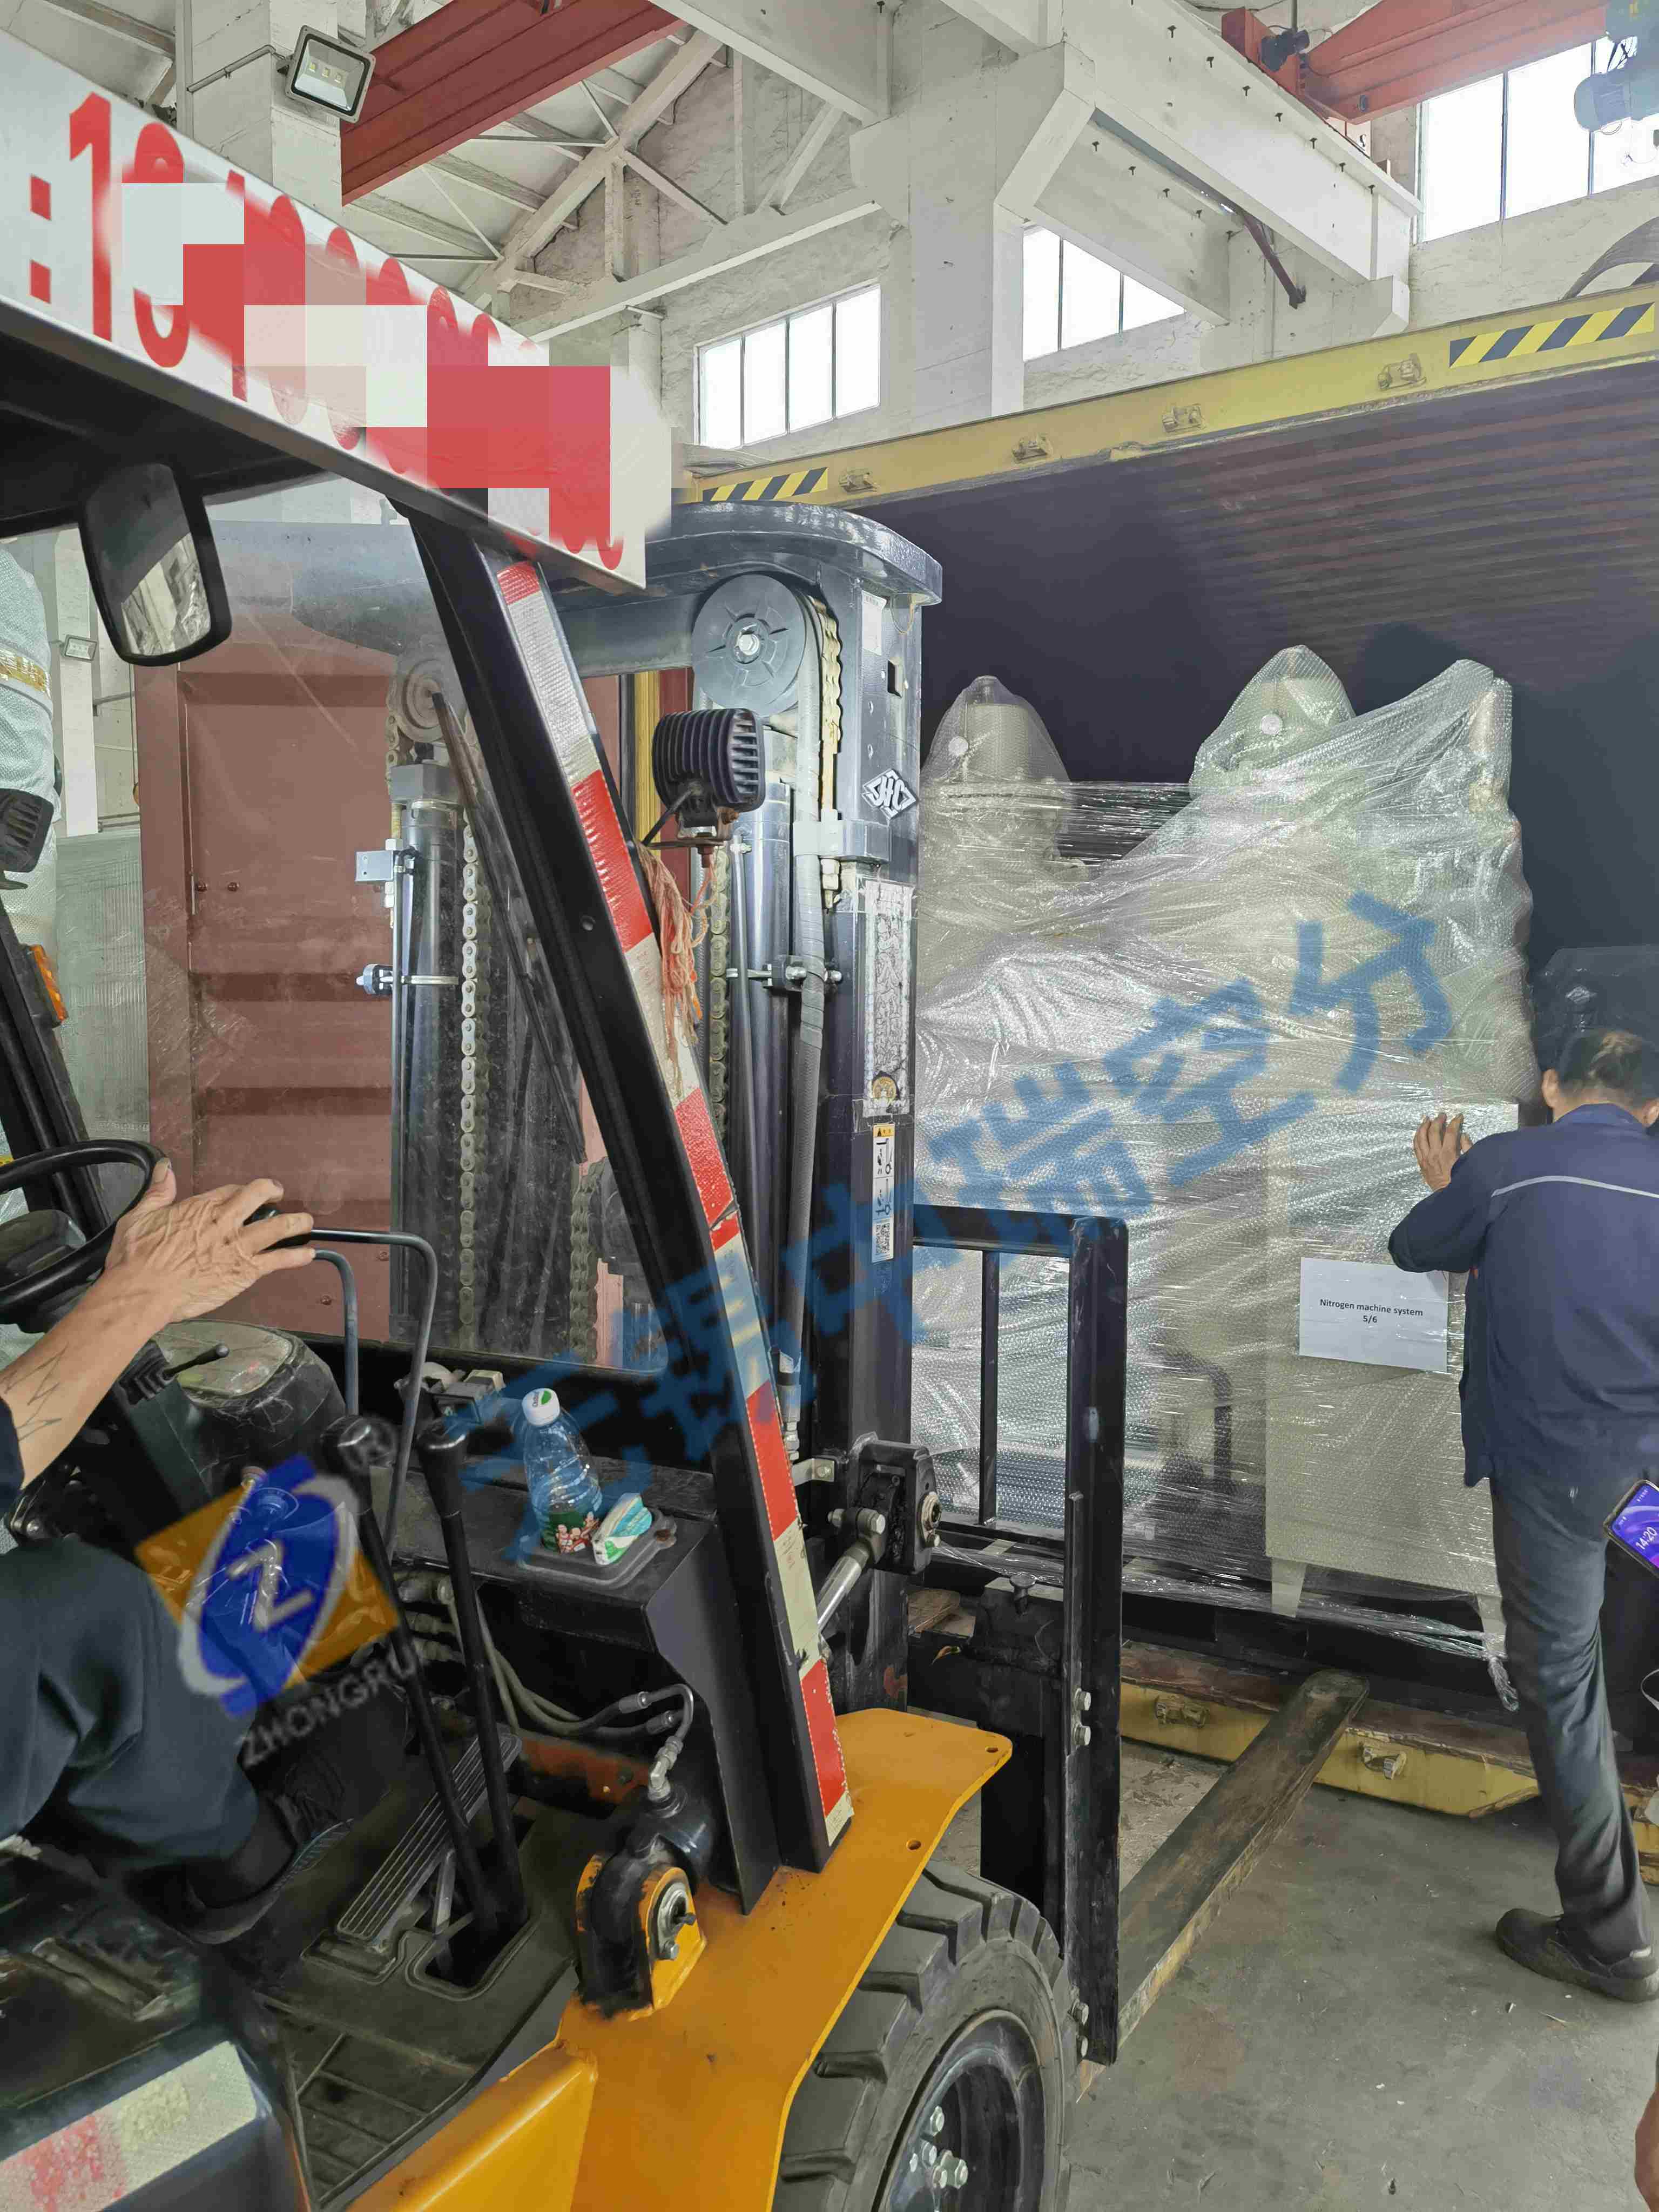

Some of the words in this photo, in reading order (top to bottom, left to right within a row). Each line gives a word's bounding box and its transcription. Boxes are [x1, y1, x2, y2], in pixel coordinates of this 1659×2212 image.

[1320, 1299, 1354, 1310] Nitrogen
[1357, 1304, 1391, 1313] machine
[1393, 1308, 1423, 1316] system
[1363, 1315, 1378, 1324] 5/6
